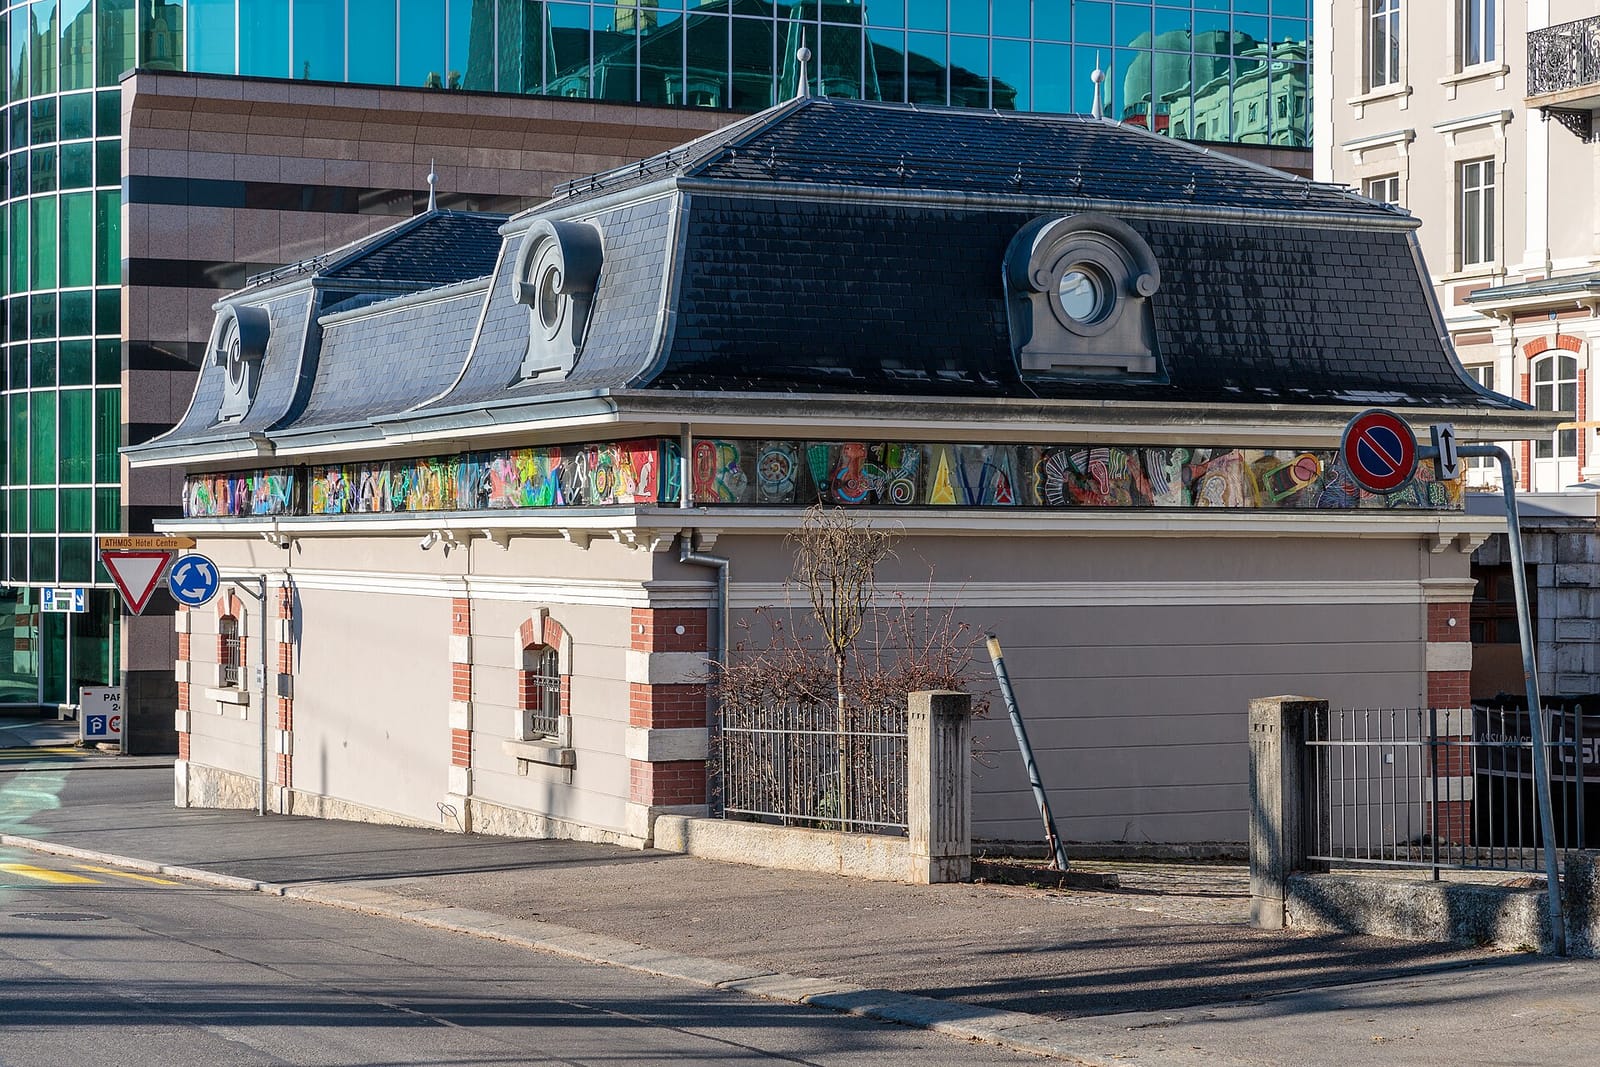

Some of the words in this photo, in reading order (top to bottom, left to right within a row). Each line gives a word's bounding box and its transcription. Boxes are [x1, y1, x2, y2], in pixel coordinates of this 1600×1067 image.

[105, 538, 132, 547] ATHMOS
[135, 538, 153, 547] Hôtel
[155, 538, 178, 547] Centre
